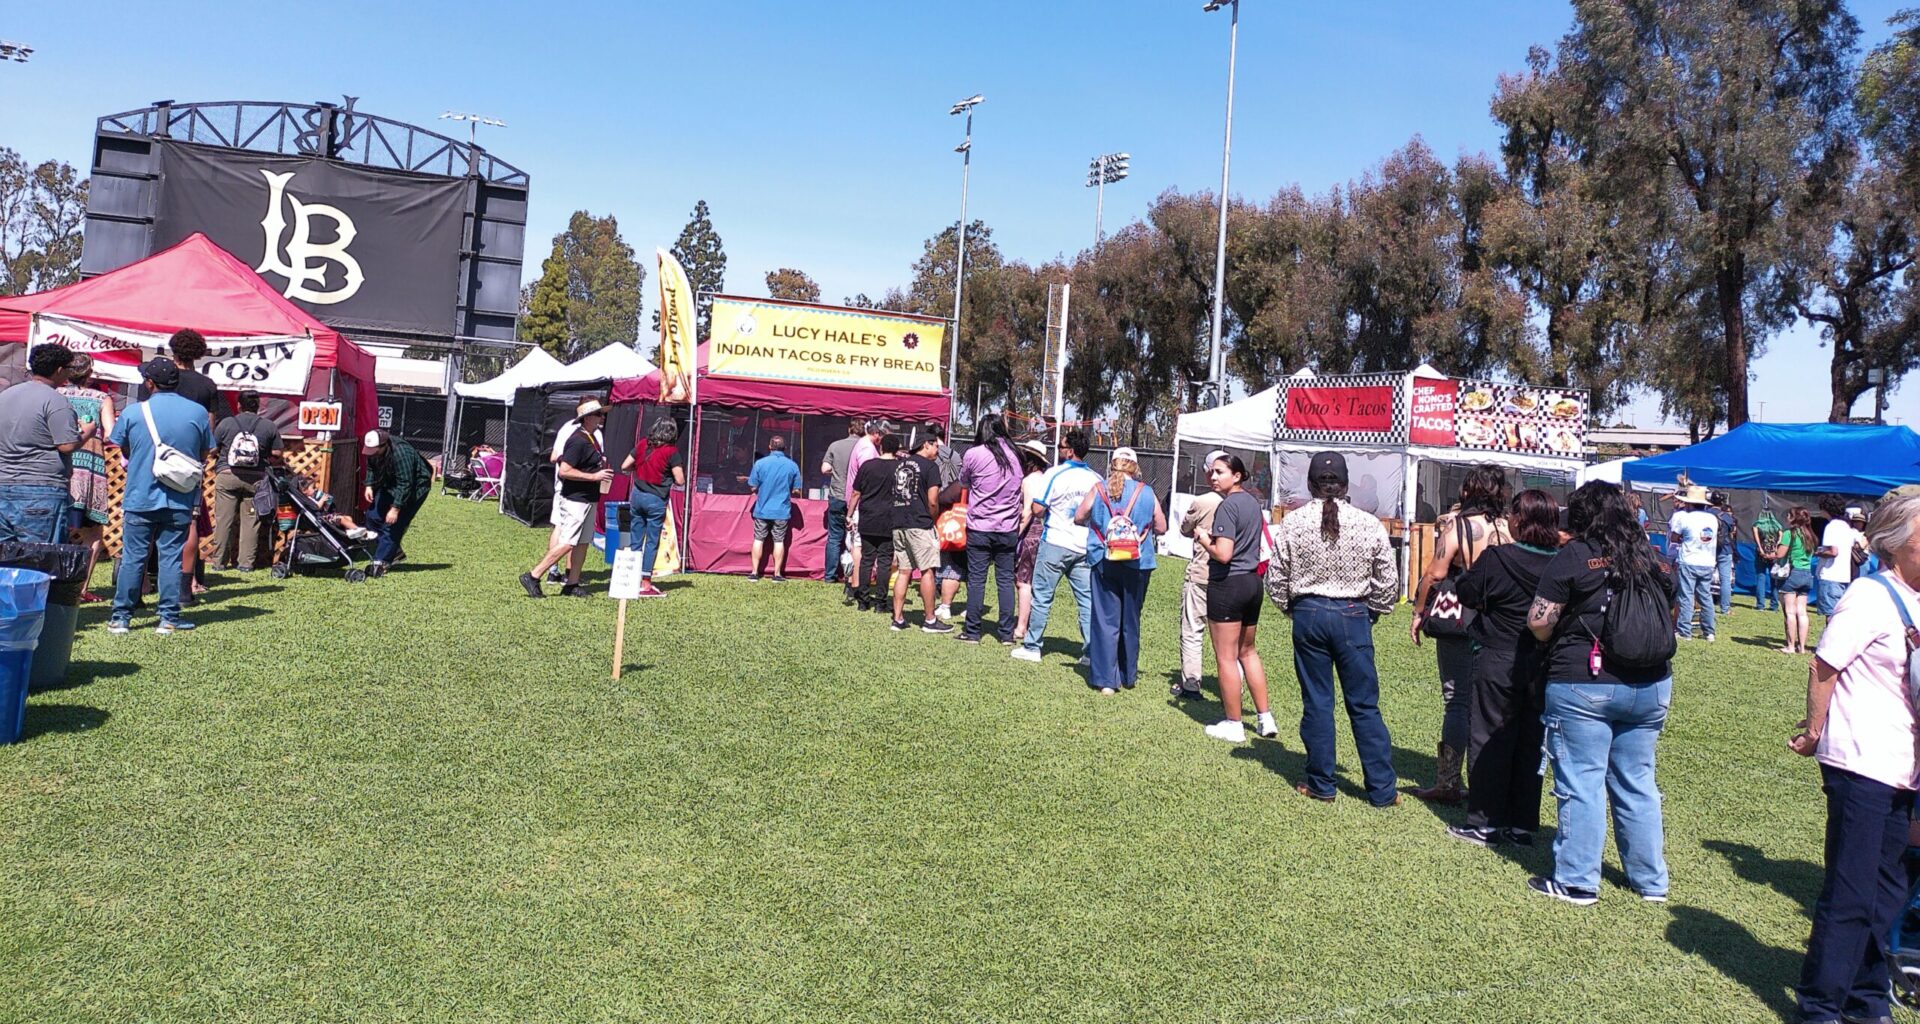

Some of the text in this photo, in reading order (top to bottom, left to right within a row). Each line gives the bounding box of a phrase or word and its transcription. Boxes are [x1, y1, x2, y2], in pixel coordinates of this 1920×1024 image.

[255, 169, 366, 305] LB
[773, 325, 887, 347] LUCY HALE'S
[154, 342, 295, 360] IDIAN
[717, 343, 935, 373] INDIAN TACOS & FRY BREAD
[202, 360, 270, 381] COS
[1413, 386, 1436, 396] CHEF
[301, 406, 339, 425] OPEN
[378, 408, 392, 420] 25
[1346, 397, 1388, 416] Tacos
[1413, 402, 1454, 414] CRAFTED
[1412, 415, 1453, 432] TACOS
